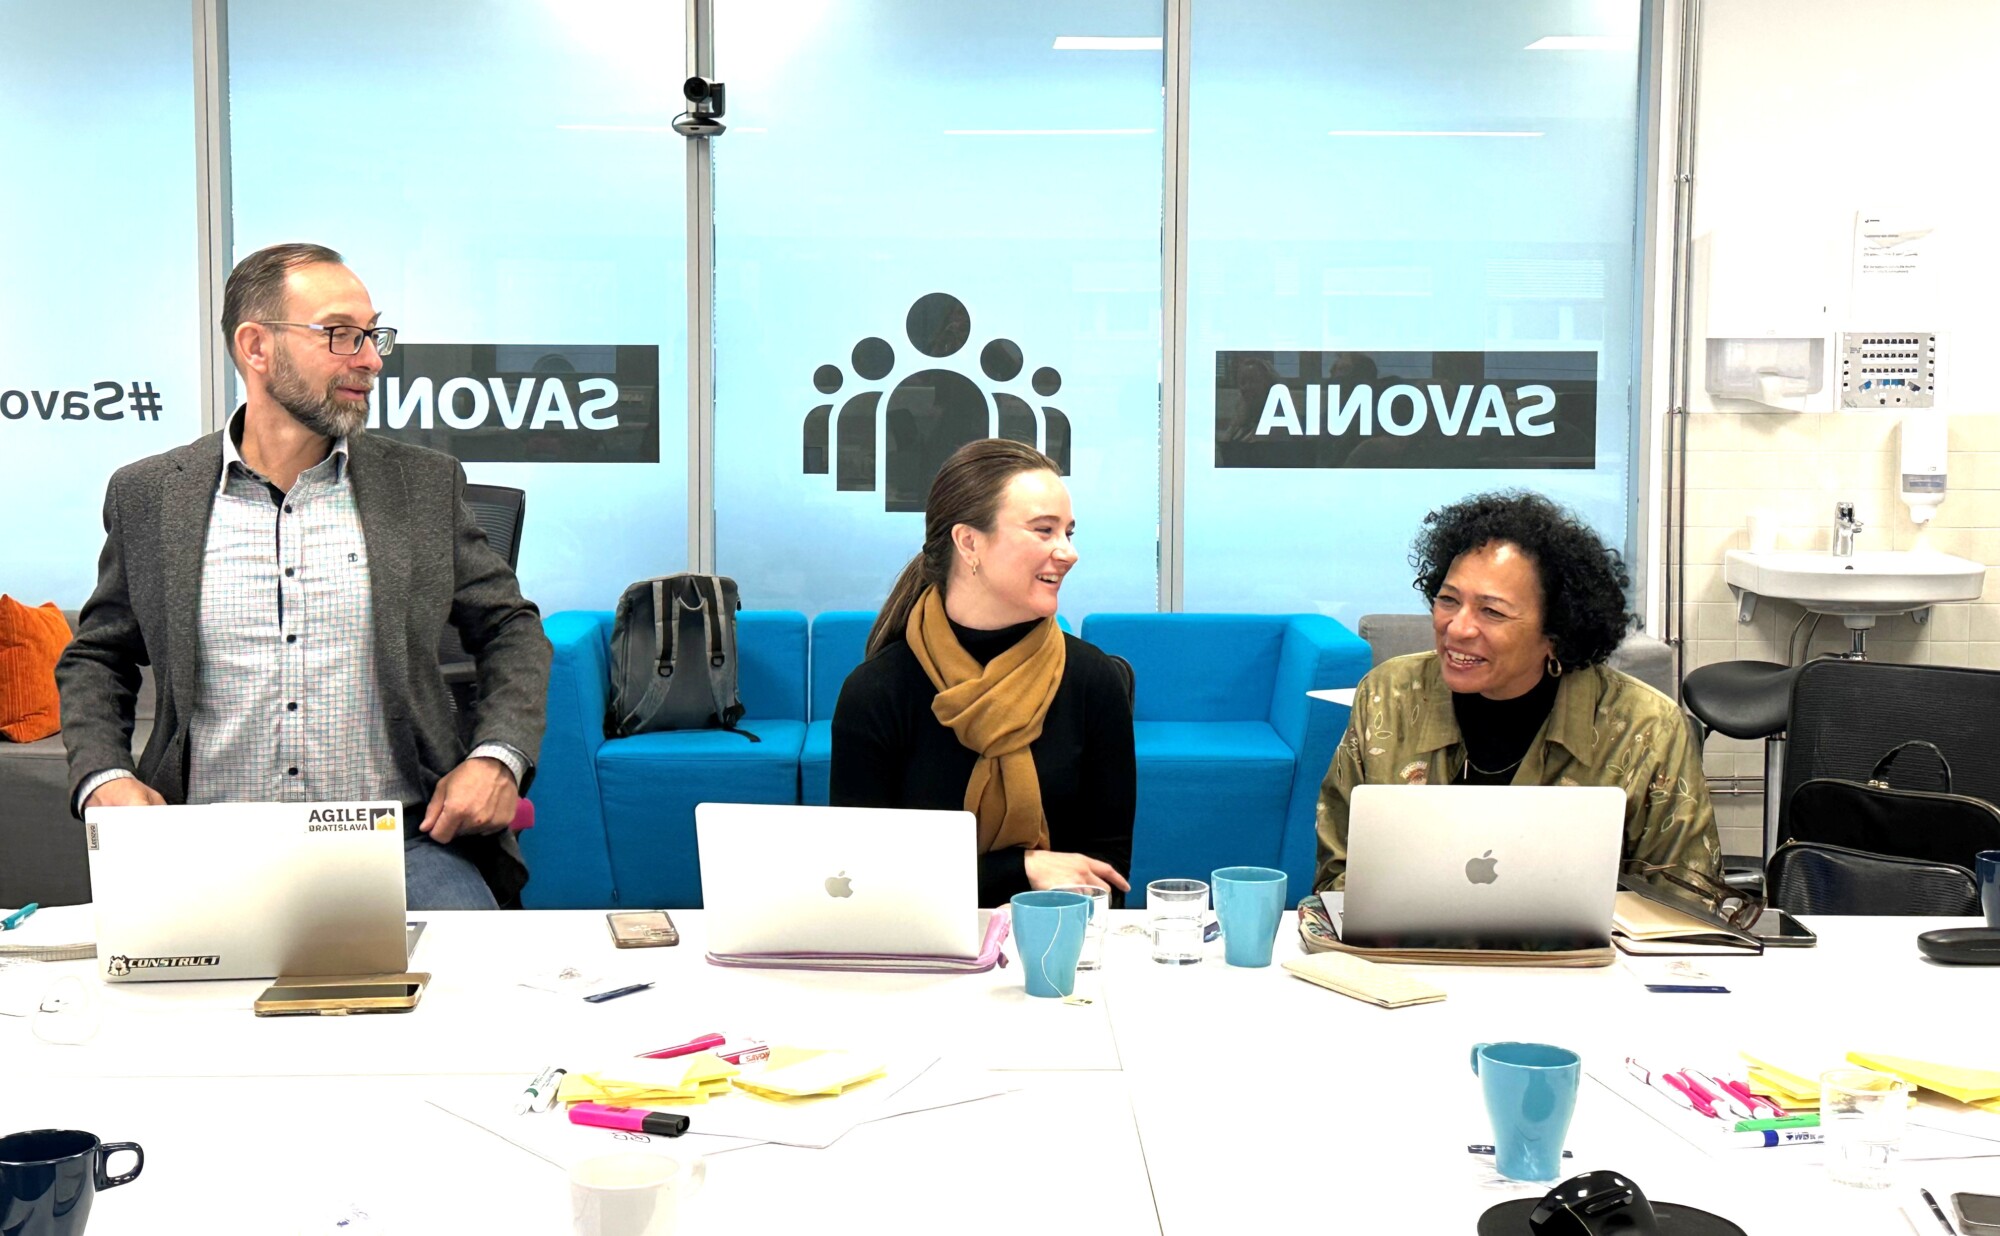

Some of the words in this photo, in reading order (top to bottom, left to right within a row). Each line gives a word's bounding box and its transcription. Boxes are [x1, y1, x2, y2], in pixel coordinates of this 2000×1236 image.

[309, 808, 368, 823] AGILE
[309, 824, 368, 832] BRATISLAVA
[128, 956, 219, 968] CONSTRUCT
